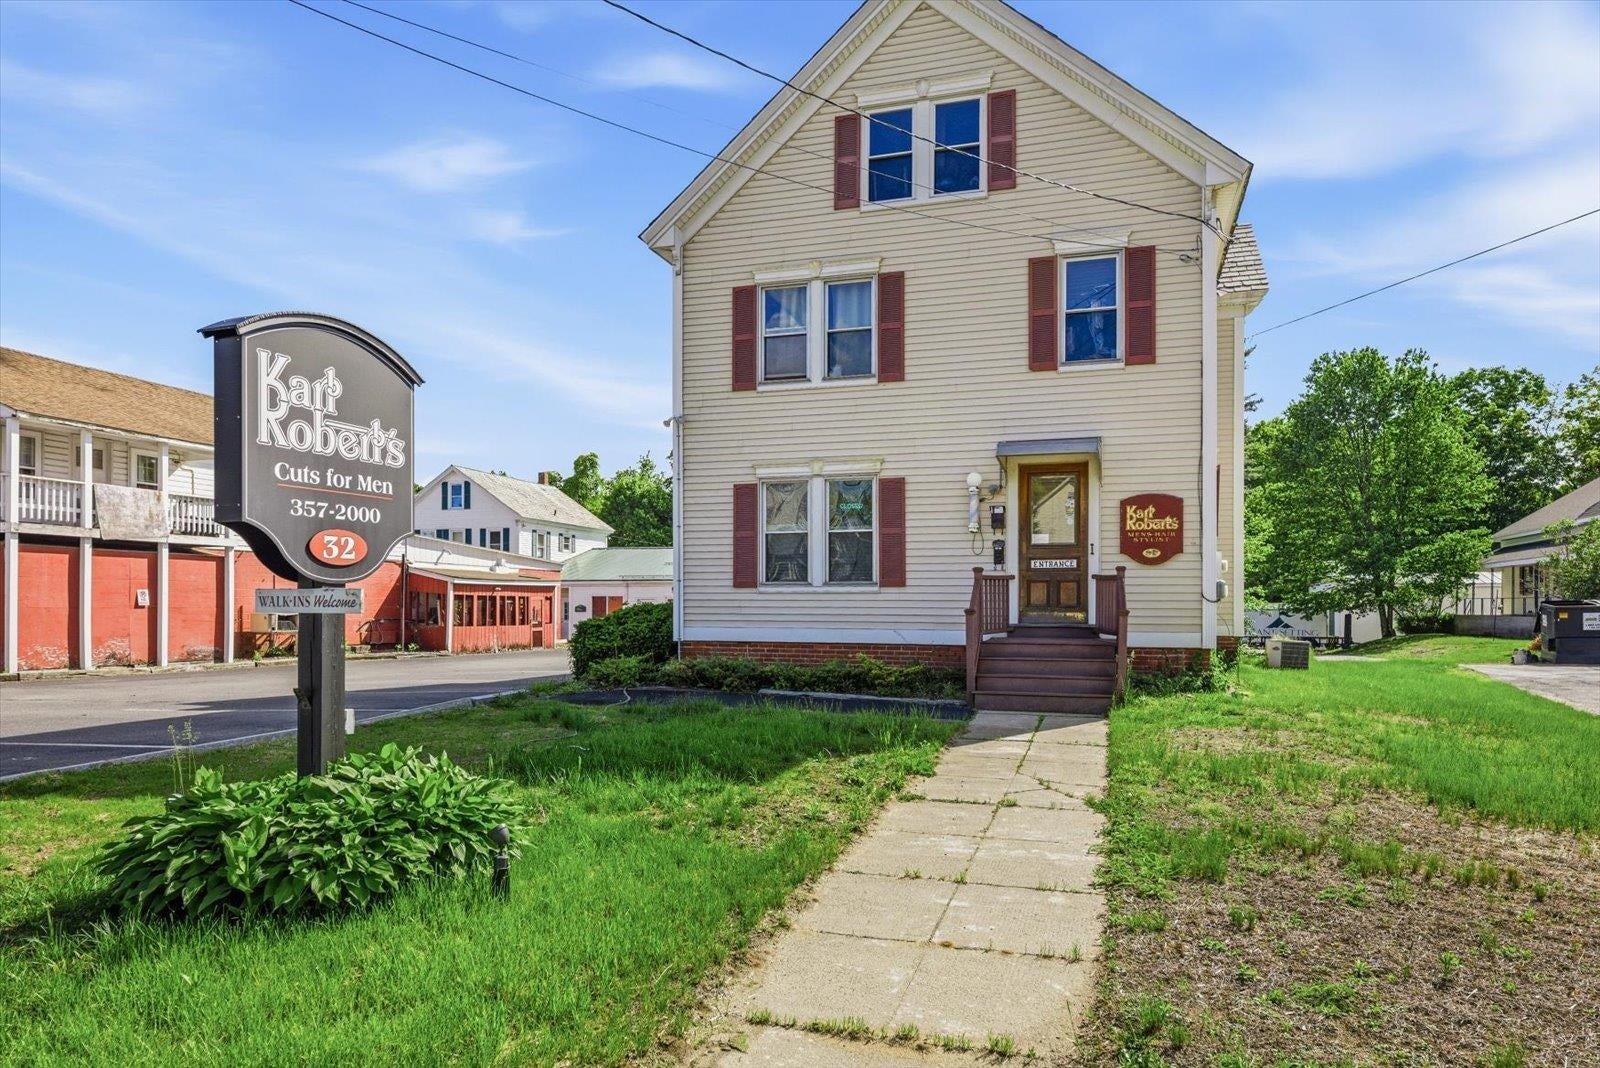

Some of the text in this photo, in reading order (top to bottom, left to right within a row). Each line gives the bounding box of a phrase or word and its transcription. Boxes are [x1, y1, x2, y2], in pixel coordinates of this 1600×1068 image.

[256, 348, 343, 415] Karl
[256, 402, 405, 468] Robert's
[274, 462, 393, 495] Cuts for Men
[290, 498, 381, 524] 357-2000
[323, 535, 356, 560] 32
[1033, 560, 1075, 568] ENTRANCE
[313, 594, 357, 608] Welcome
